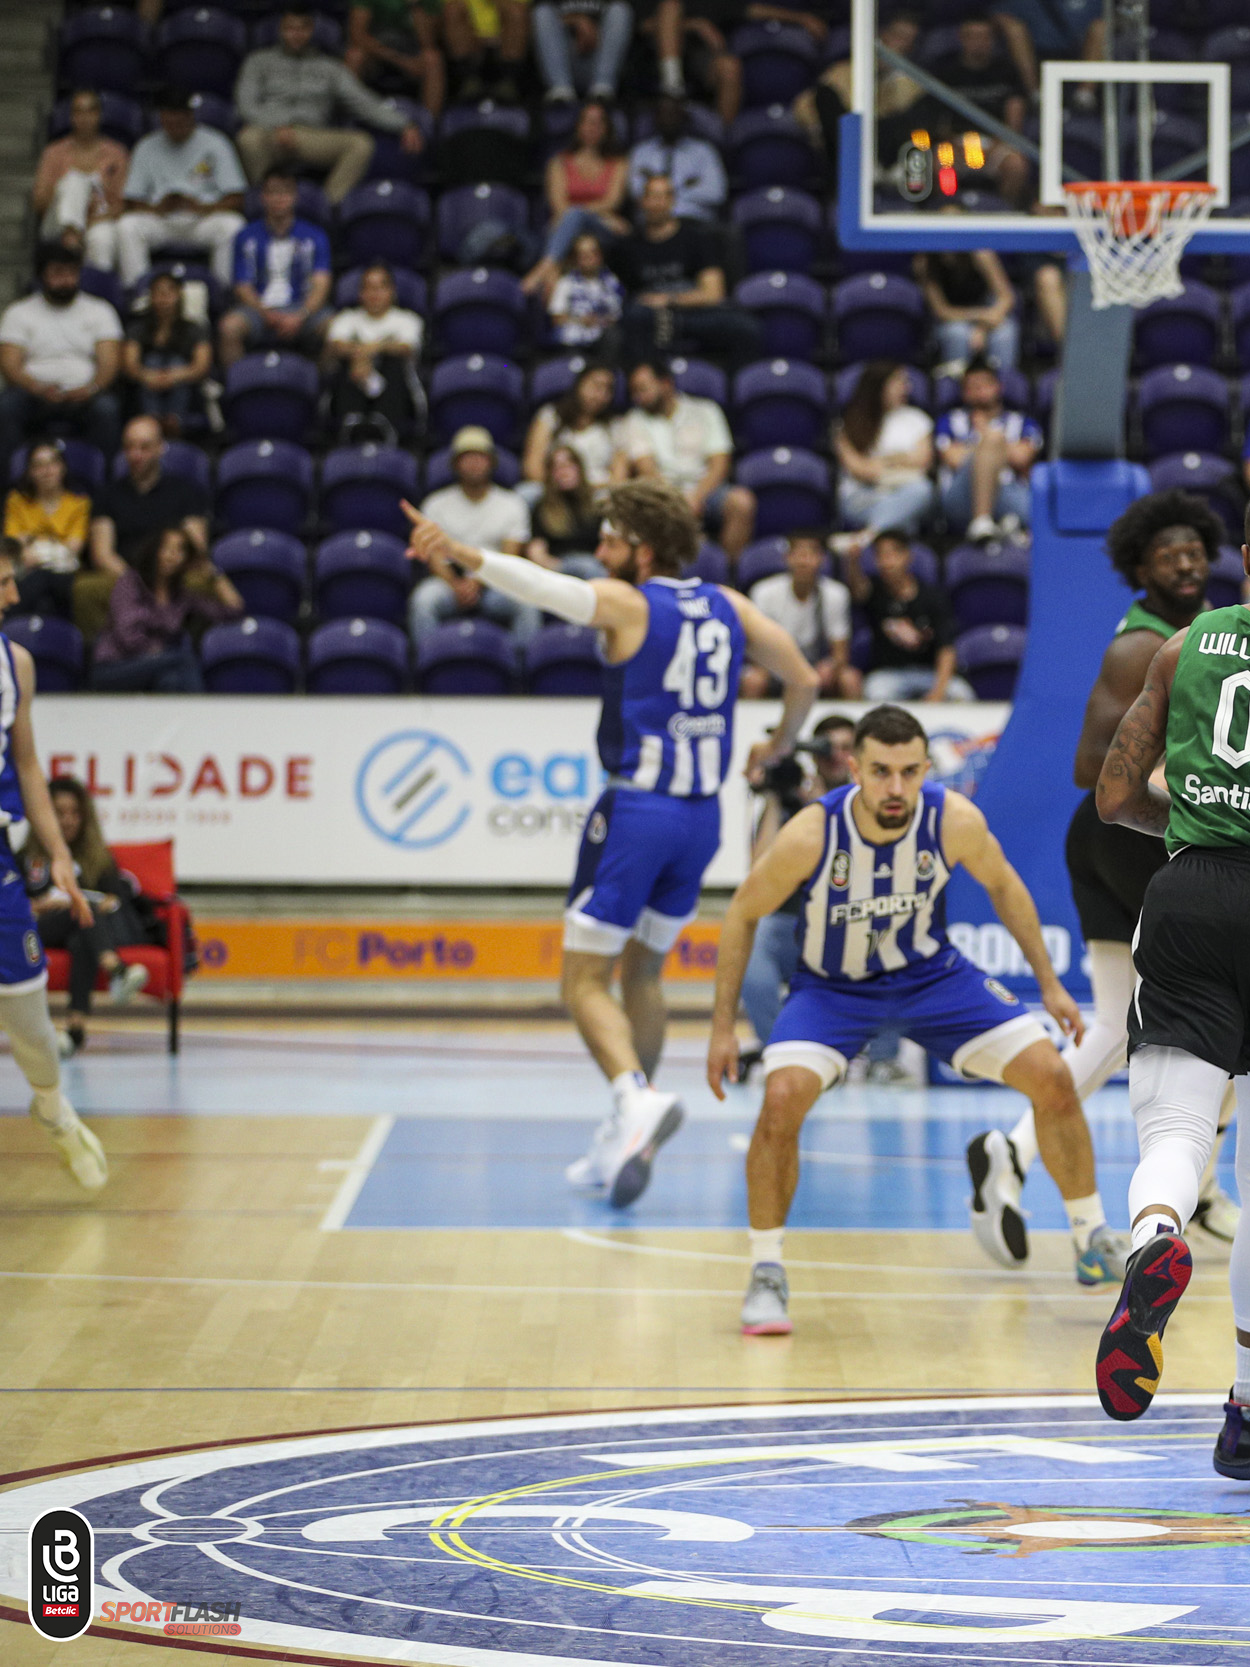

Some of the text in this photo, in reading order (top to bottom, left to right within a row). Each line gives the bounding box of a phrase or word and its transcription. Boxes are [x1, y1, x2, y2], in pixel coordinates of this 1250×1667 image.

[663, 618, 732, 710] 43
[492, 753, 608, 799] ea
[358, 931, 476, 969] Porto
